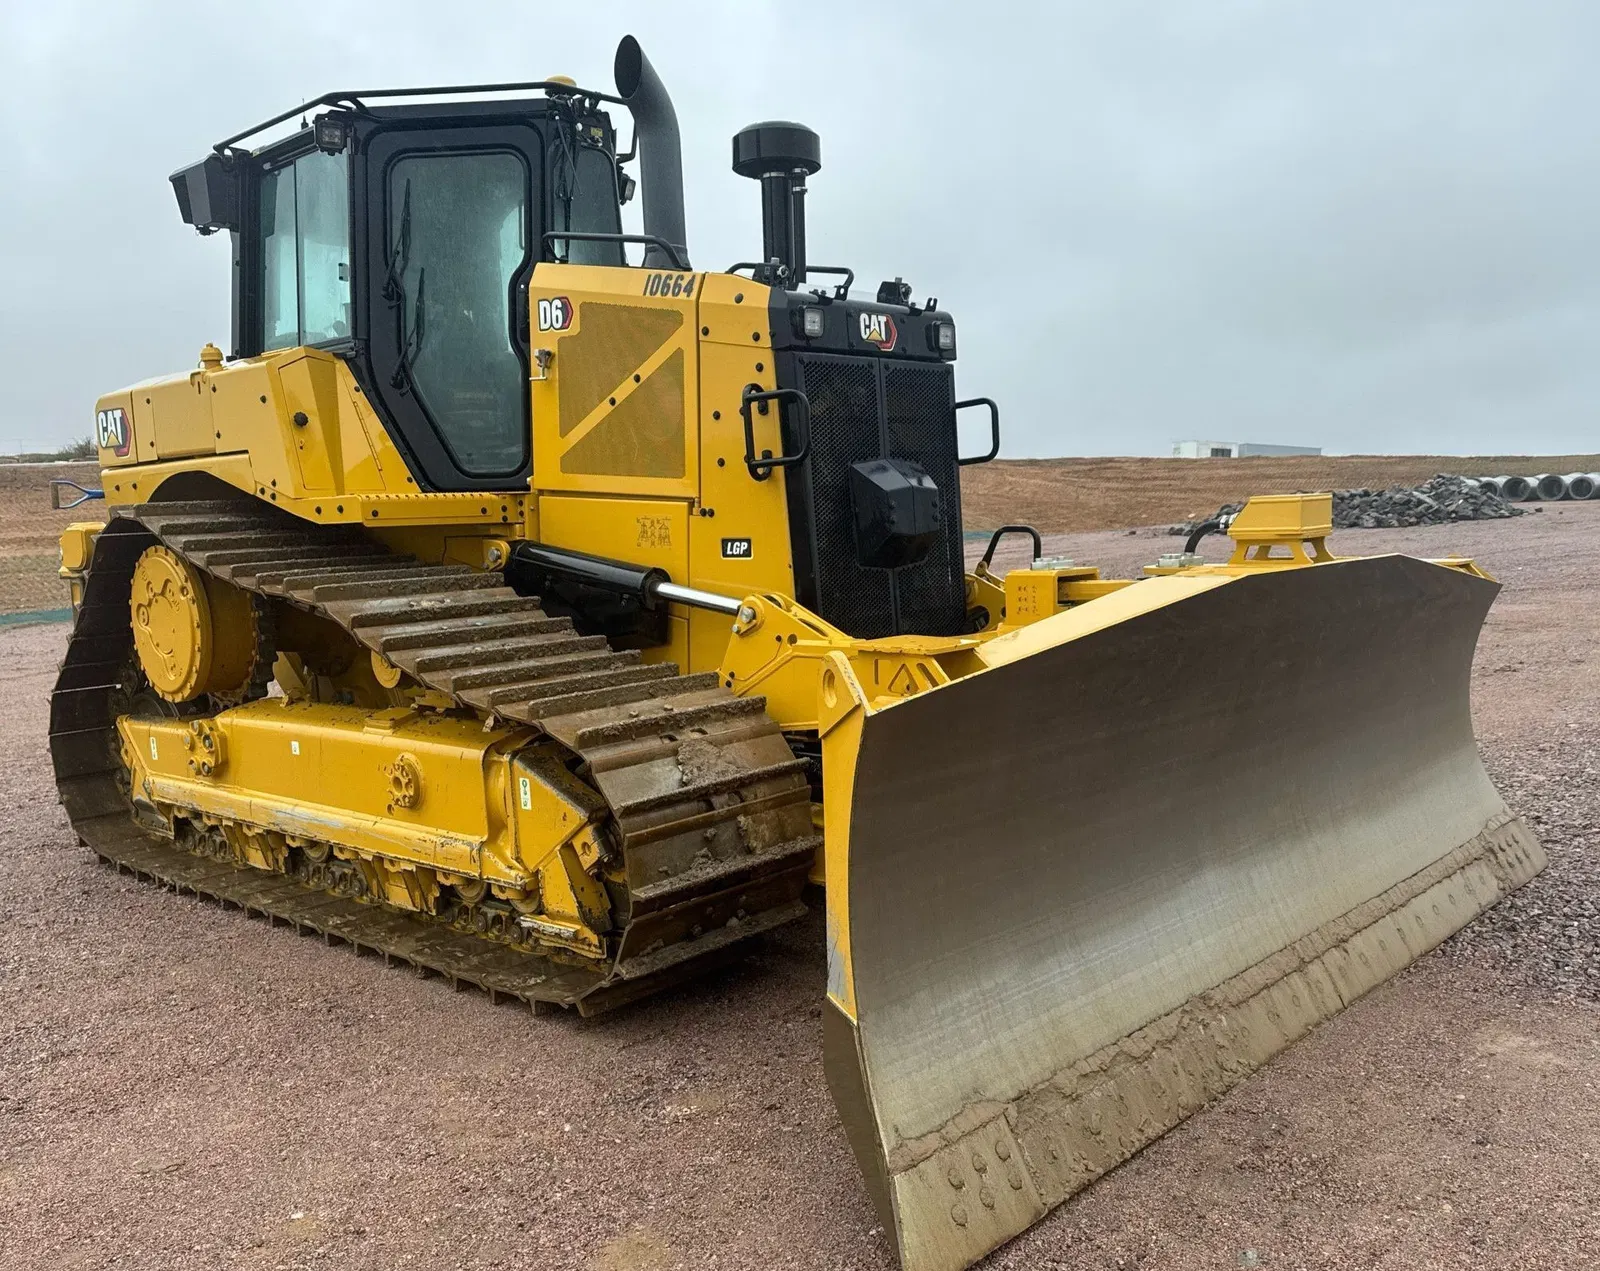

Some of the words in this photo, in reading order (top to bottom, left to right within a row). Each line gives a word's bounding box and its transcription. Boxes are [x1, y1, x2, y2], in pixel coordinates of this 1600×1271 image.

[643, 273, 696, 298] 10664
[538, 298, 563, 331] D6
[860, 313, 887, 342] CAT
[98, 409, 123, 448] CAT
[726, 541, 748, 555] LGP
